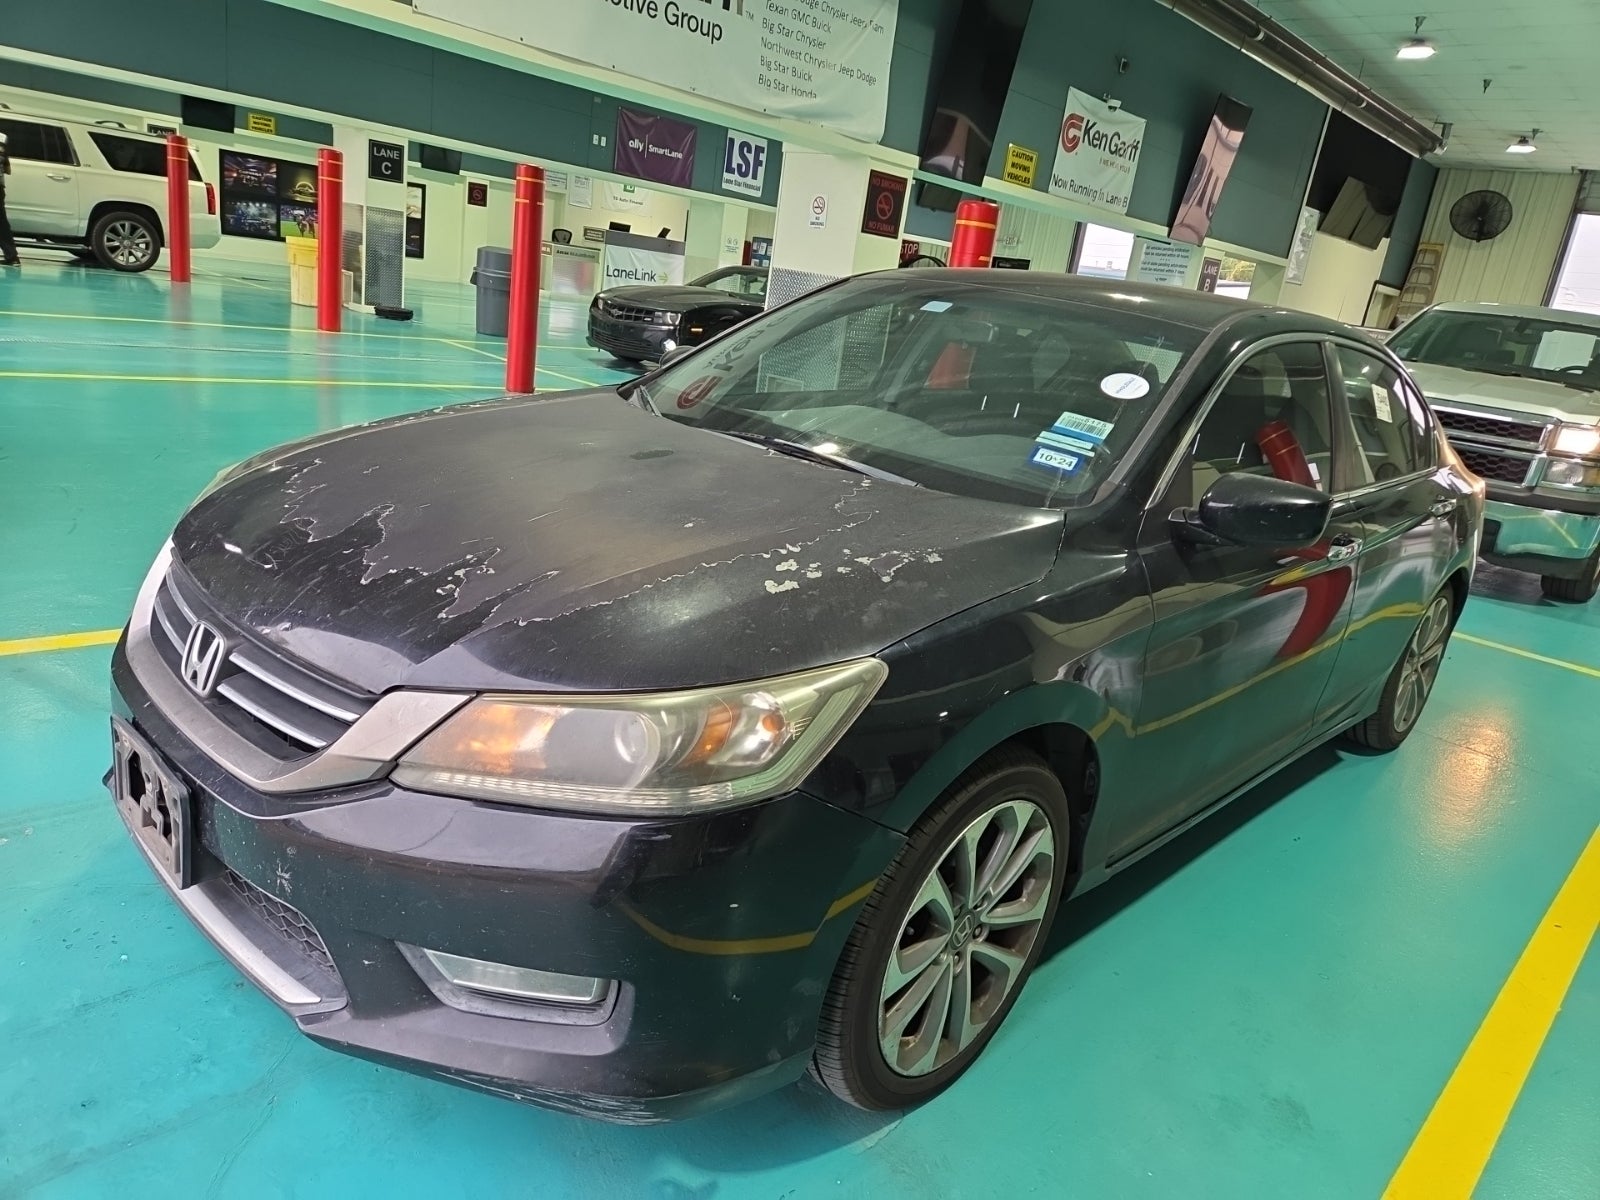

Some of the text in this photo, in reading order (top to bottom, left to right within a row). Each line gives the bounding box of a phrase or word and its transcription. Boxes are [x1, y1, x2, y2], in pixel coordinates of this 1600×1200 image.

[764, 0, 832, 35] Texan GMC Buick
[821, 0, 849, 22] Chrysler
[664, 0, 723, 45] Group
[762, 17, 827, 51] Big Star Chrysler
[760, 36, 877, 87] Northwest Chrysler Jeep Dodge
[760, 55, 813, 83] Big Star Buick
[773, 78, 790, 94] Star
[791, 83, 817, 99] Honda
[373, 146, 400, 160] LANE
[628, 138, 683, 160] ally SmartLane
[724, 137, 766, 181] LSF
[1011, 150, 1034, 162] CAUTION
[381, 161, 392, 175] C
[1010, 161, 1031, 173] MOVING
[1007, 171, 1031, 185] VEHICLES
[1051, 173, 1129, 208] Now Running in Lane B
[605, 264, 657, 283] LaneLink
[1203, 264, 1219, 276] LANE
[1203, 278, 1211, 292] B
